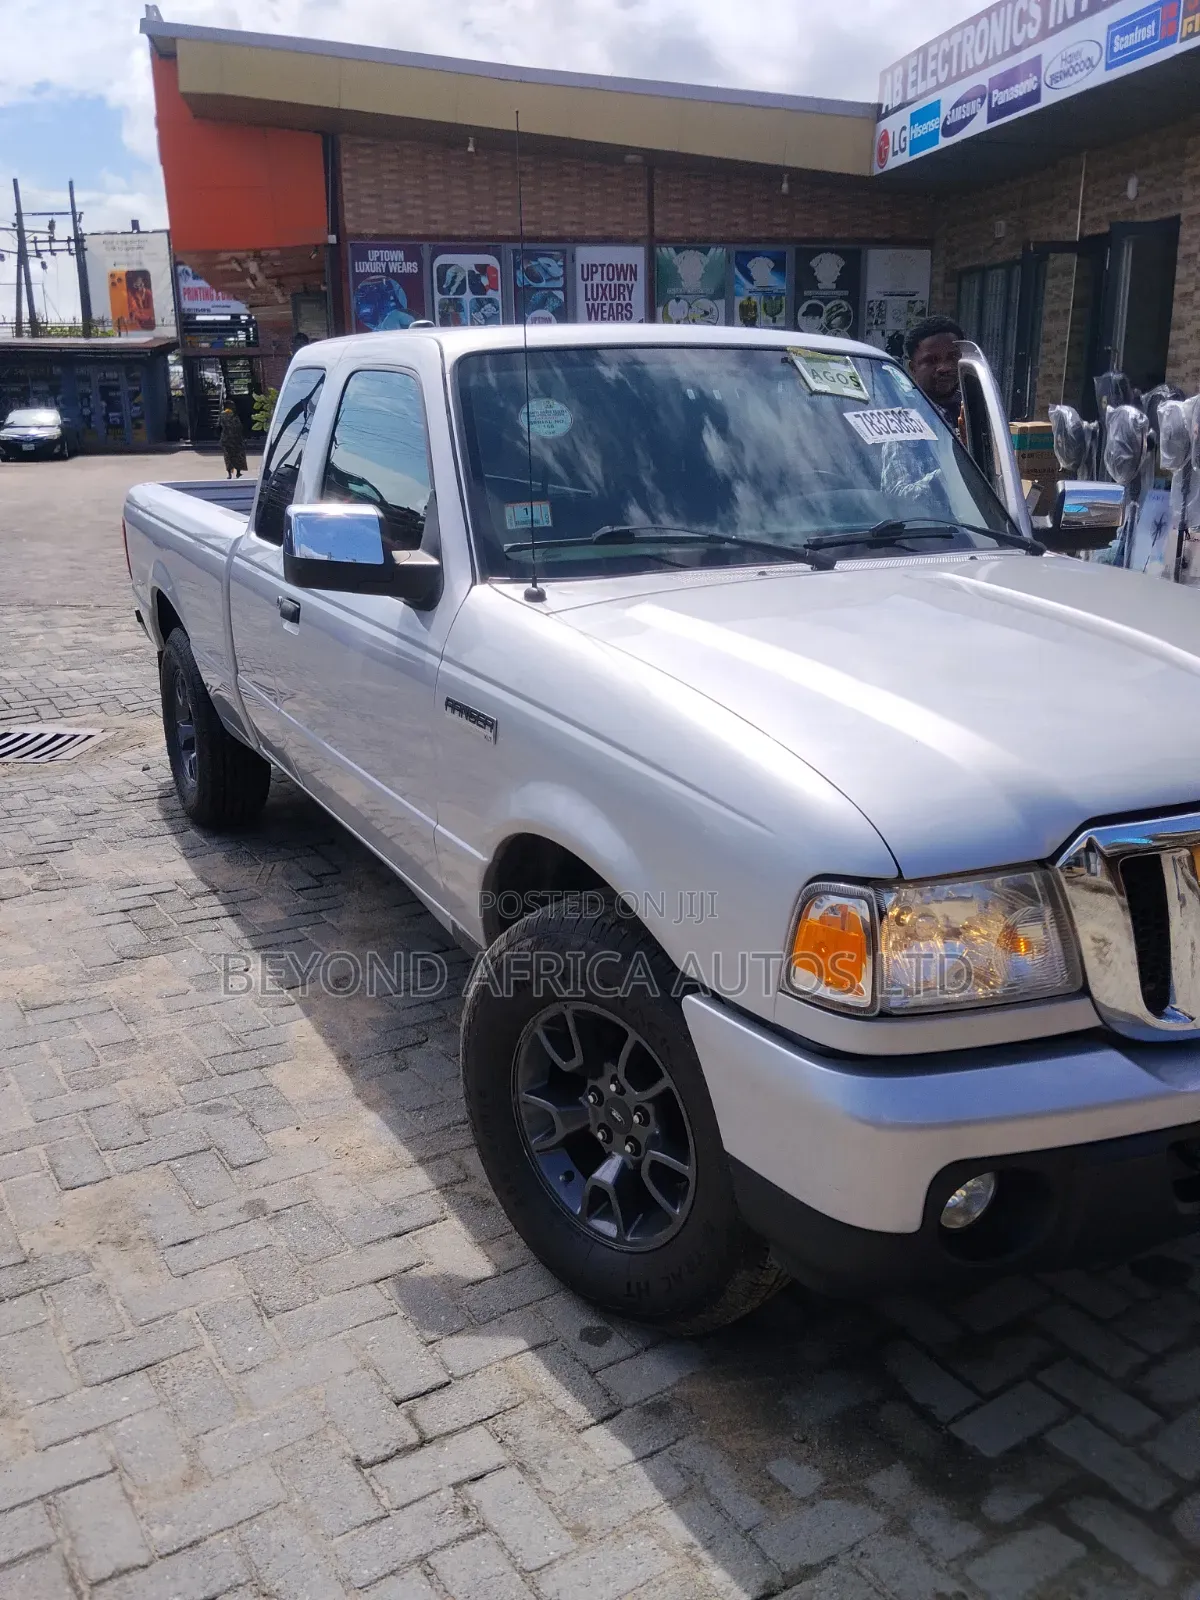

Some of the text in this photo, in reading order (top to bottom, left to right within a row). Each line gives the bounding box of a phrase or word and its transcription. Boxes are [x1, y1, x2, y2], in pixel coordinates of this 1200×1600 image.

[1113, 19, 1156, 53] Scanfrost
[882, 68, 903, 113] AB
[907, 0, 1042, 98] ELECTRONICS
[992, 74, 1038, 107] Panasonic
[946, 97, 982, 126] SAMSUNG
[891, 125, 907, 157] LG
[910, 116, 940, 141] Hisense
[355, 261, 418, 273] LUXURY WEARS
[368, 250, 404, 262] UPTOWN
[580, 263, 638, 283] UPTOWN
[584, 283, 634, 302] LUXURY
[586, 302, 634, 322] WEARS
